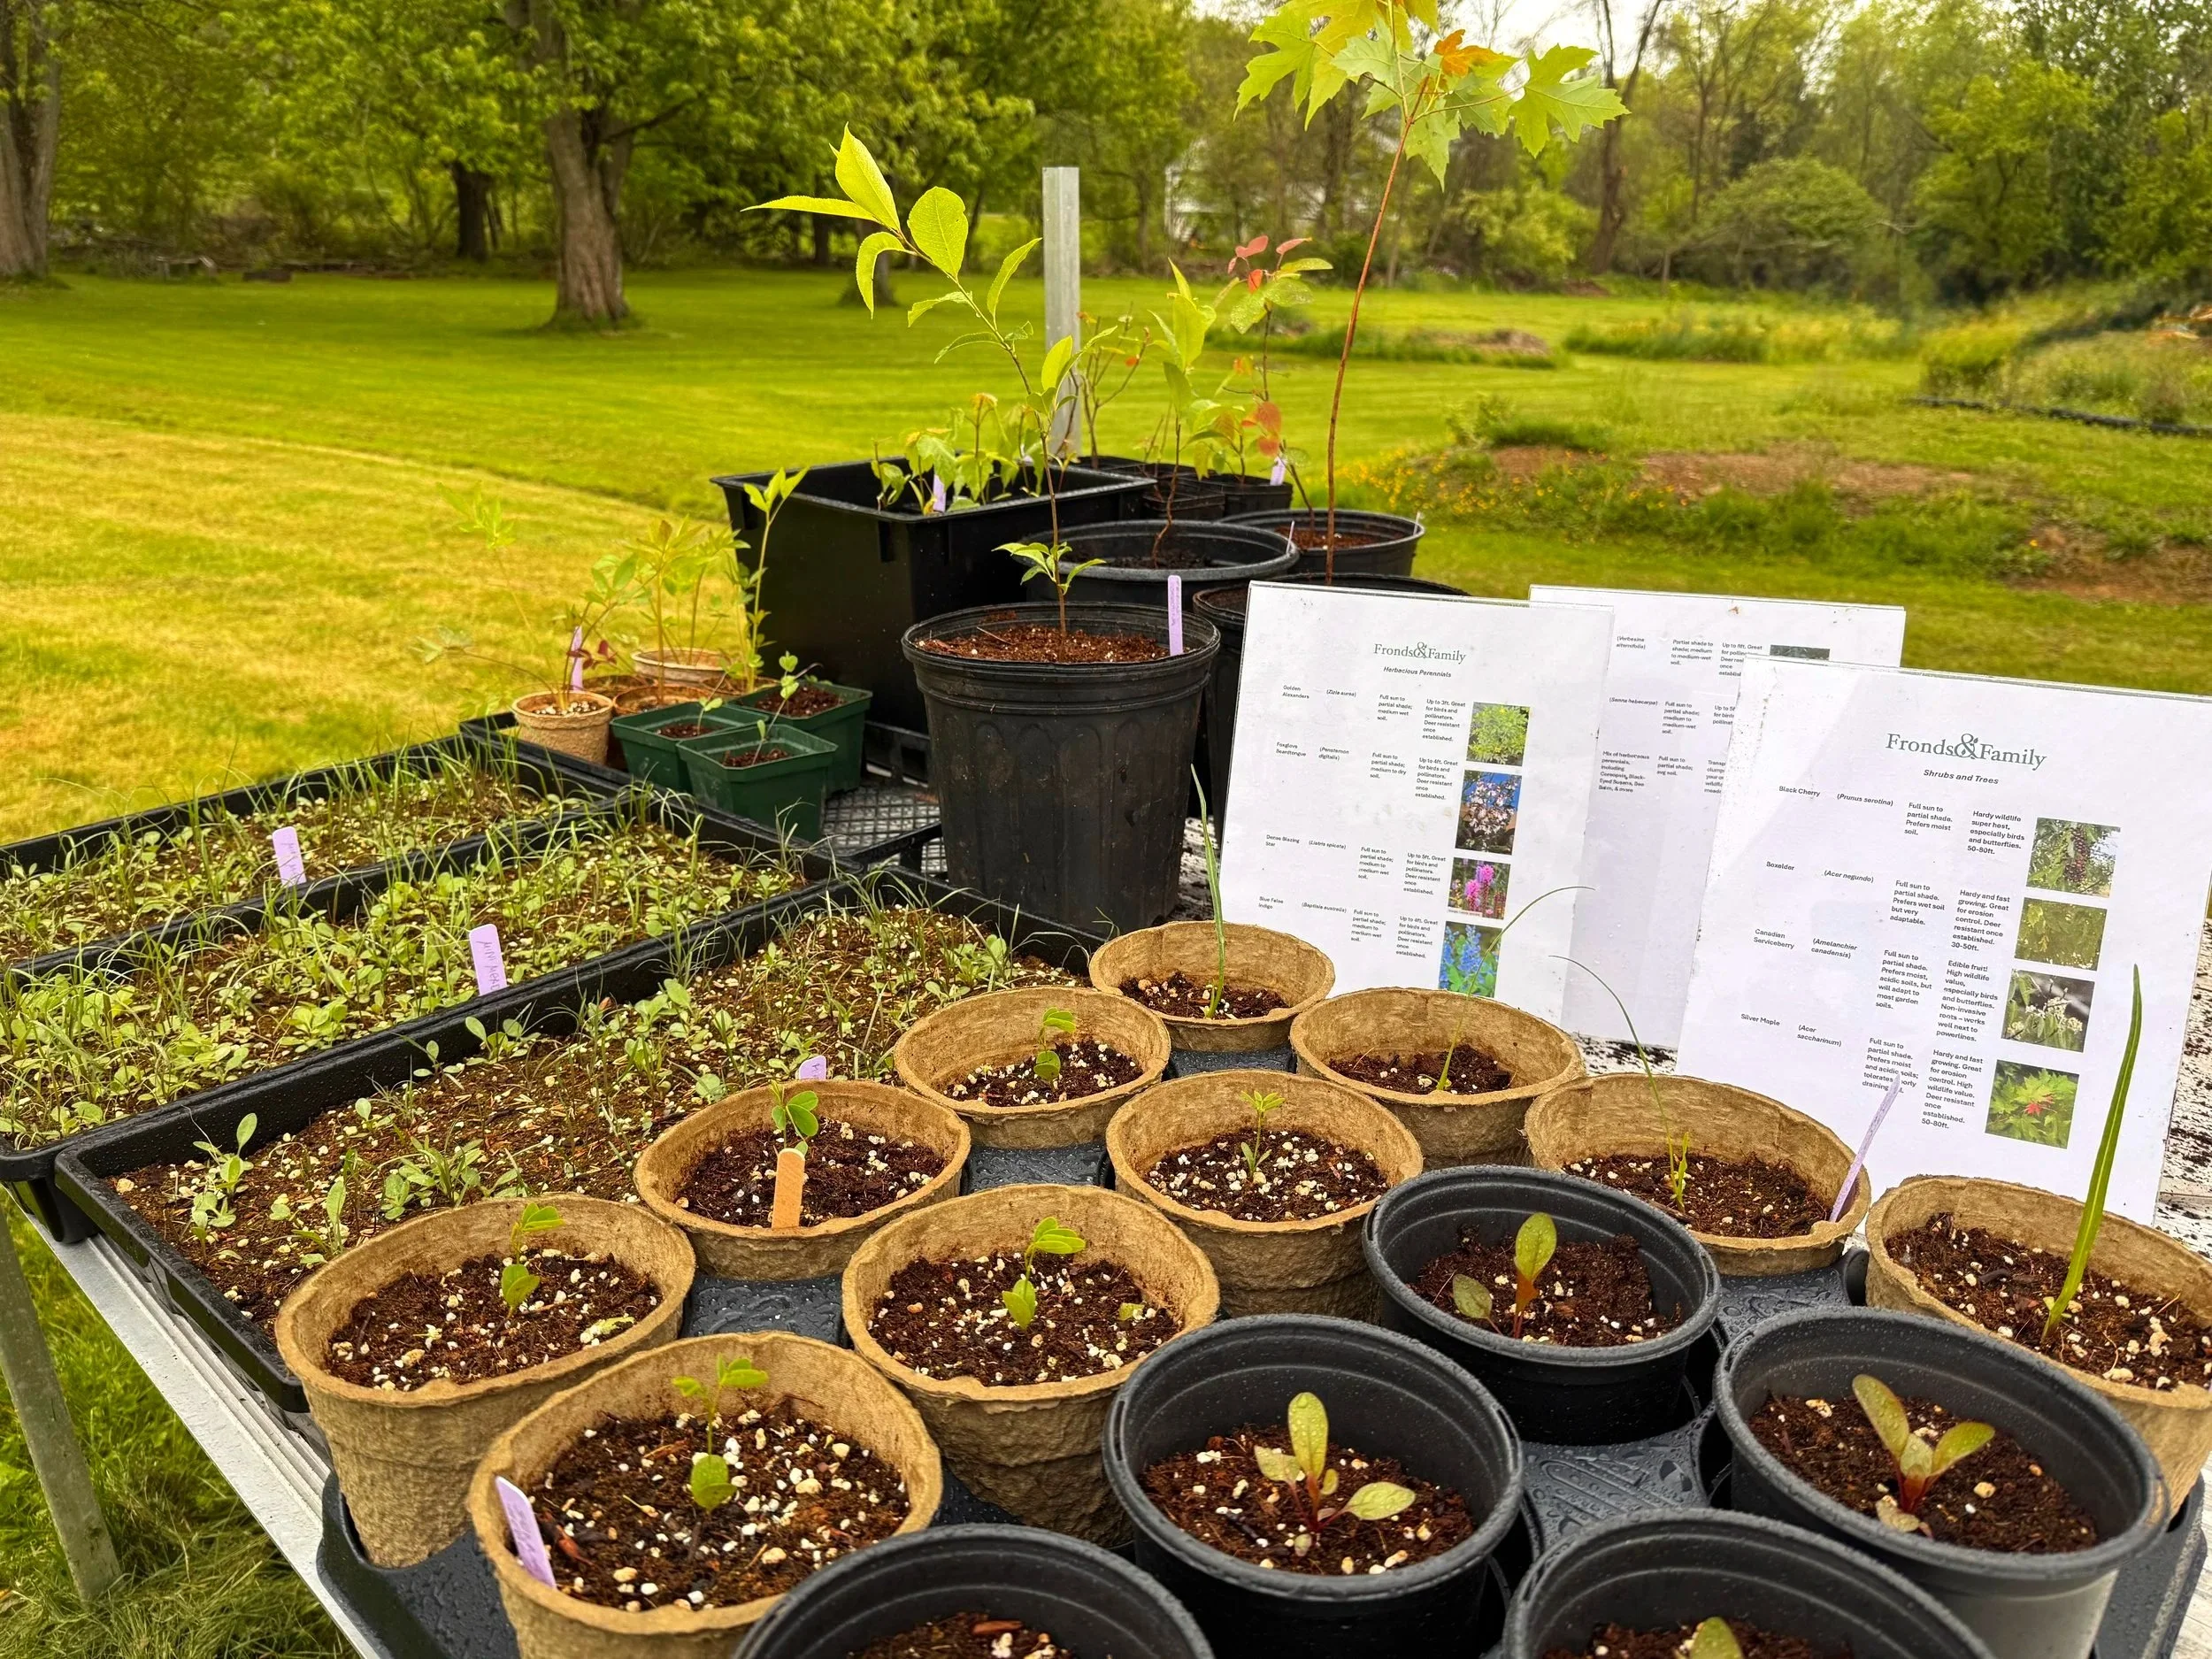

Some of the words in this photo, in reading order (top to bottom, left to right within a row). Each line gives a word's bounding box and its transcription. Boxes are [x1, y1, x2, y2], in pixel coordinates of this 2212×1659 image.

[1886, 733, 2047, 772] Fronds&Family
[1924, 769, 1955, 780] Shrubs
[1975, 775, 1999, 784] Trees
[1798, 788, 1821, 797] Cherry
[1837, 793, 1863, 802] (Prunus
[1863, 798, 1893, 807] serotina)
[1972, 810, 1994, 820] Hardy
[1906, 819, 1930, 828] Prefers
[1970, 829, 2006, 839] especially
[1982, 838, 2022, 849] butterflies.
[1967, 845, 1995, 855] 50-80ft.
[1766, 861, 1794, 871] Boxelder
[1842, 874, 1874, 884] negundo)
[1960, 889, 1981, 899] Hardy
[1893, 897, 1917, 906] Prefers
[1957, 899, 1987, 909] growing.
[1989, 902, 2009, 911] Great
[1890, 915, 1925, 926] adaptable.
[1955, 917, 1983, 926] control.
[1984, 919, 2001, 928] Deer
[1755, 928, 1786, 939] Canadian
[1954, 926, 1985, 934] resistant
[1754, 936, 1794, 949] Serviceberry
[1812, 938, 1858, 950] (Amelanchier
[1952, 934, 1995, 945] established.
[1951, 941, 1979, 951] 30-50ft.
[1811, 948, 1851, 959] canadensis)
[1881, 966, 1906, 976] Prefers
[1905, 963, 1928, 972] shade.
[1947, 960, 1970, 969] Edible
[1970, 964, 1988, 972] fruit!
[1963, 972, 1990, 981] wildlife
[1945, 979, 1966, 987] value,
[1943, 987, 1979, 998] especially
[1979, 992, 1998, 1001] birds
[1895, 996, 1918, 1005] garden
[1956, 997, 1994, 1009] butterflies.
[1940, 1003, 1986, 1017] Non-invasive
[1741, 1013, 1759, 1022] Silver
[1760, 1017, 1780, 1025] Maple
[1797, 1033, 1841, 1048] saccharinum)
[1936, 1030, 1977, 1041] powerlines.
